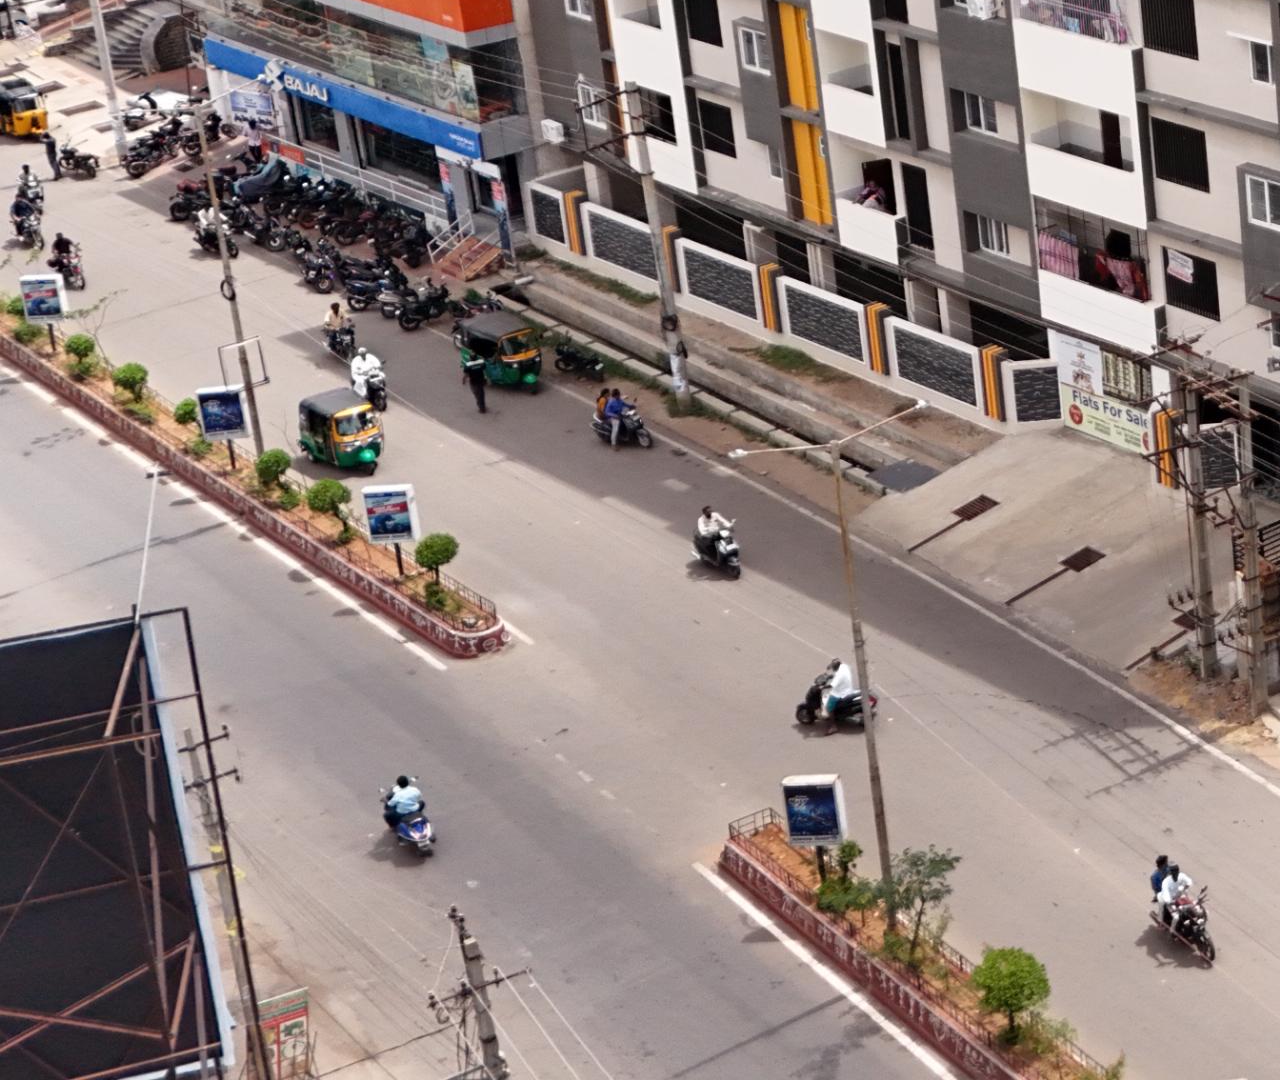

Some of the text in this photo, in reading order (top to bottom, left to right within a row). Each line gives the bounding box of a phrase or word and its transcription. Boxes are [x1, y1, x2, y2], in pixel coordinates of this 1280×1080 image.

[283, 74, 328, 101] BAJAJ
[1072, 390, 1100, 411] Flats
[1102, 401, 1122, 418] For
